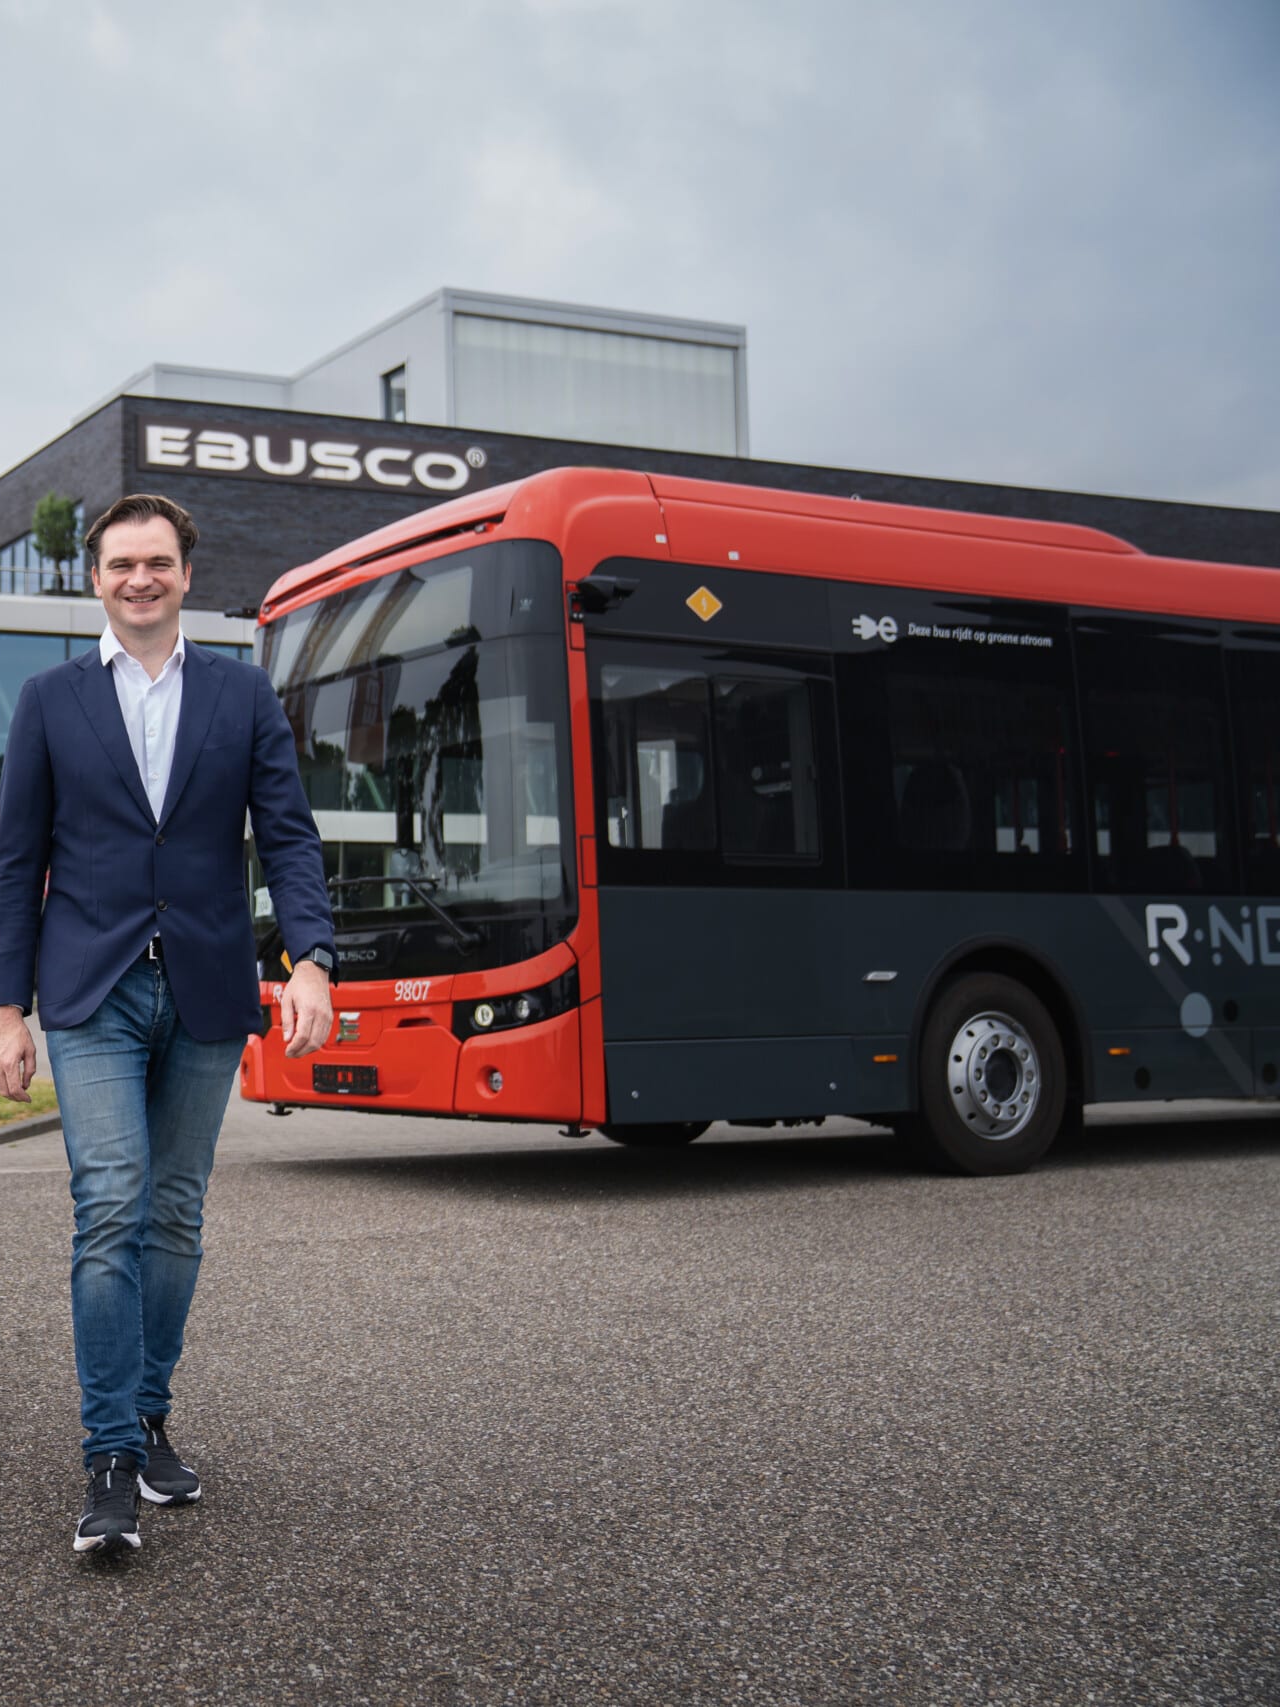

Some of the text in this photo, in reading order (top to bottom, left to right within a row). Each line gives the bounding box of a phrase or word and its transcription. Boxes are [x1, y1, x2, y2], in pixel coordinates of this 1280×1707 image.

[908, 622, 1053, 648] Deze bus rijdt op groene stroom
[394, 980, 431, 1001] 9807
